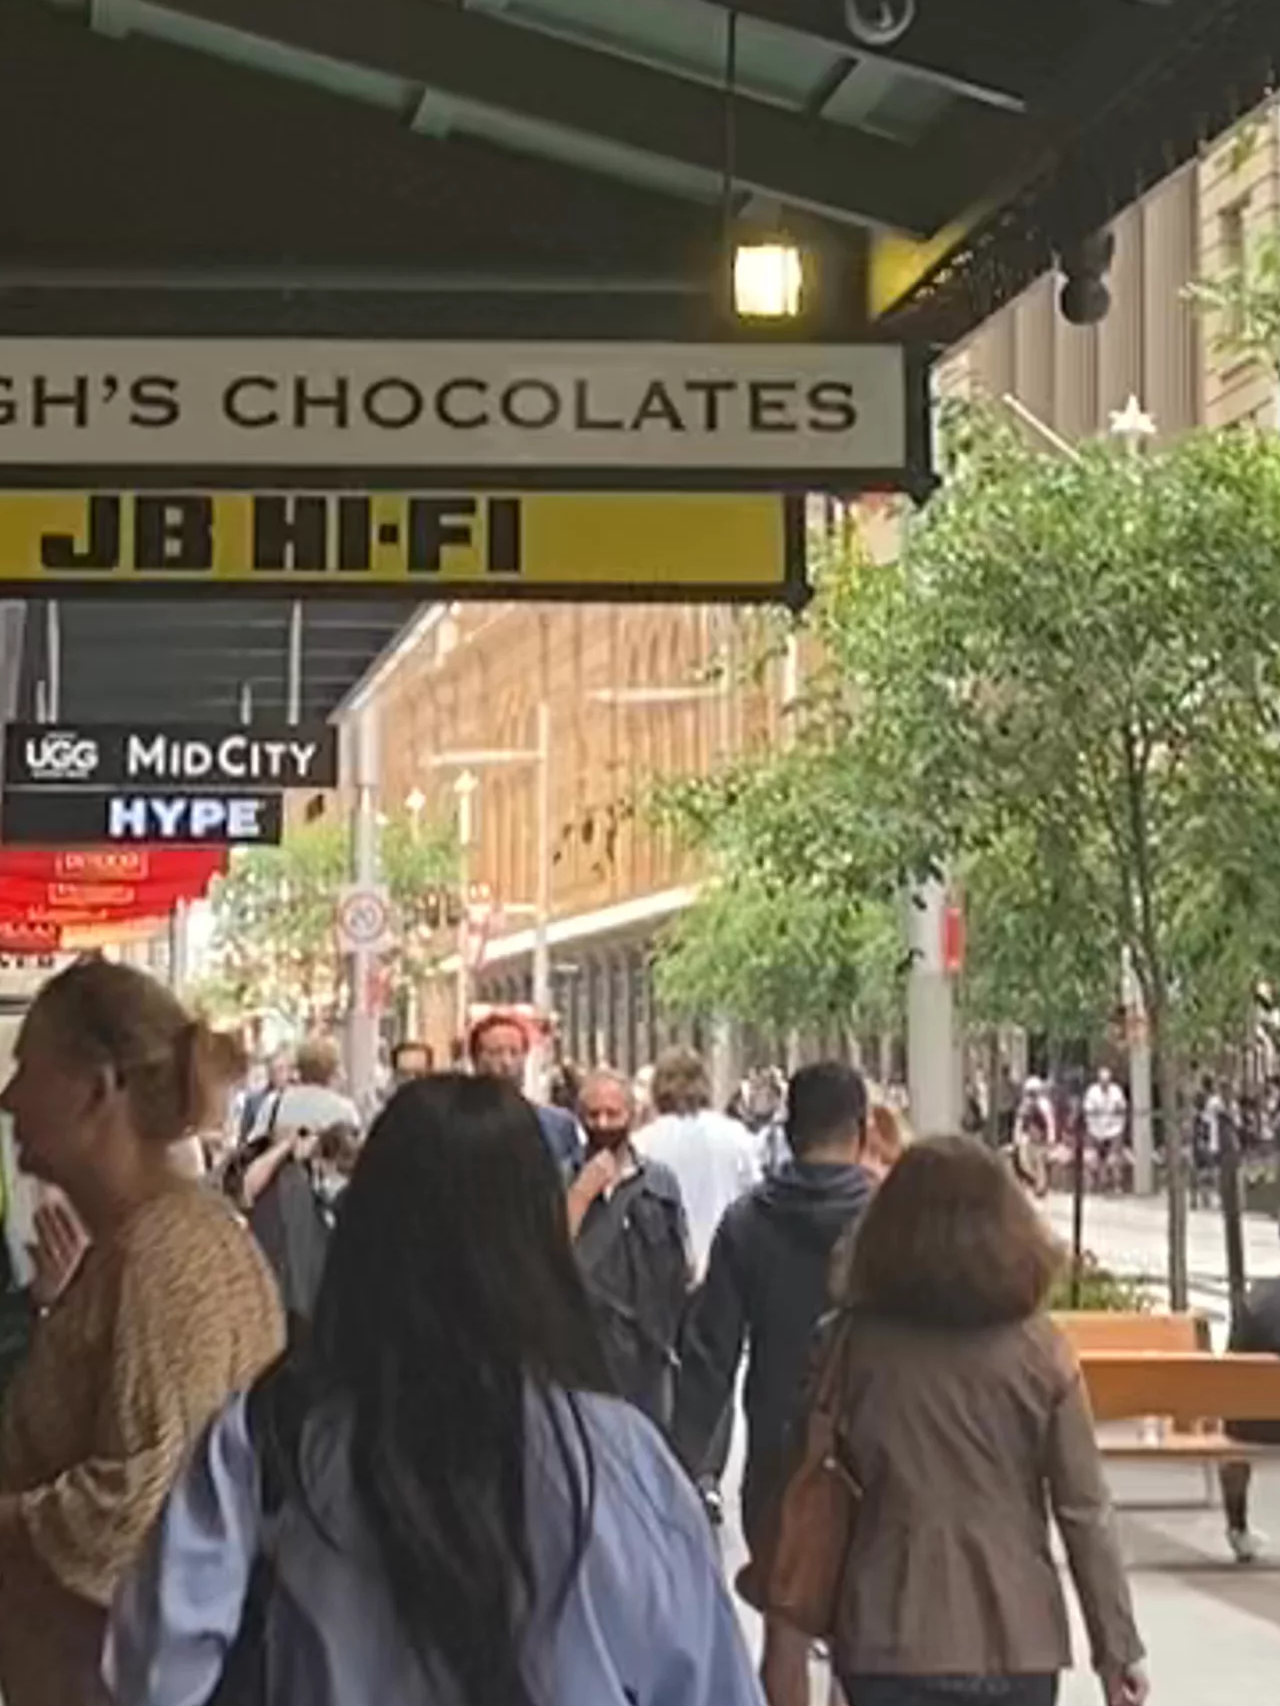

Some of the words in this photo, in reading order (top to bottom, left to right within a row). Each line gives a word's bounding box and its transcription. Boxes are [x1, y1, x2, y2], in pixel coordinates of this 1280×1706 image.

[220, 372, 861, 434] CHOCOLATES
[38, 493, 215, 573] JB
[25, 739, 100, 770] UGG
[108, 797, 263, 839] HYPE
